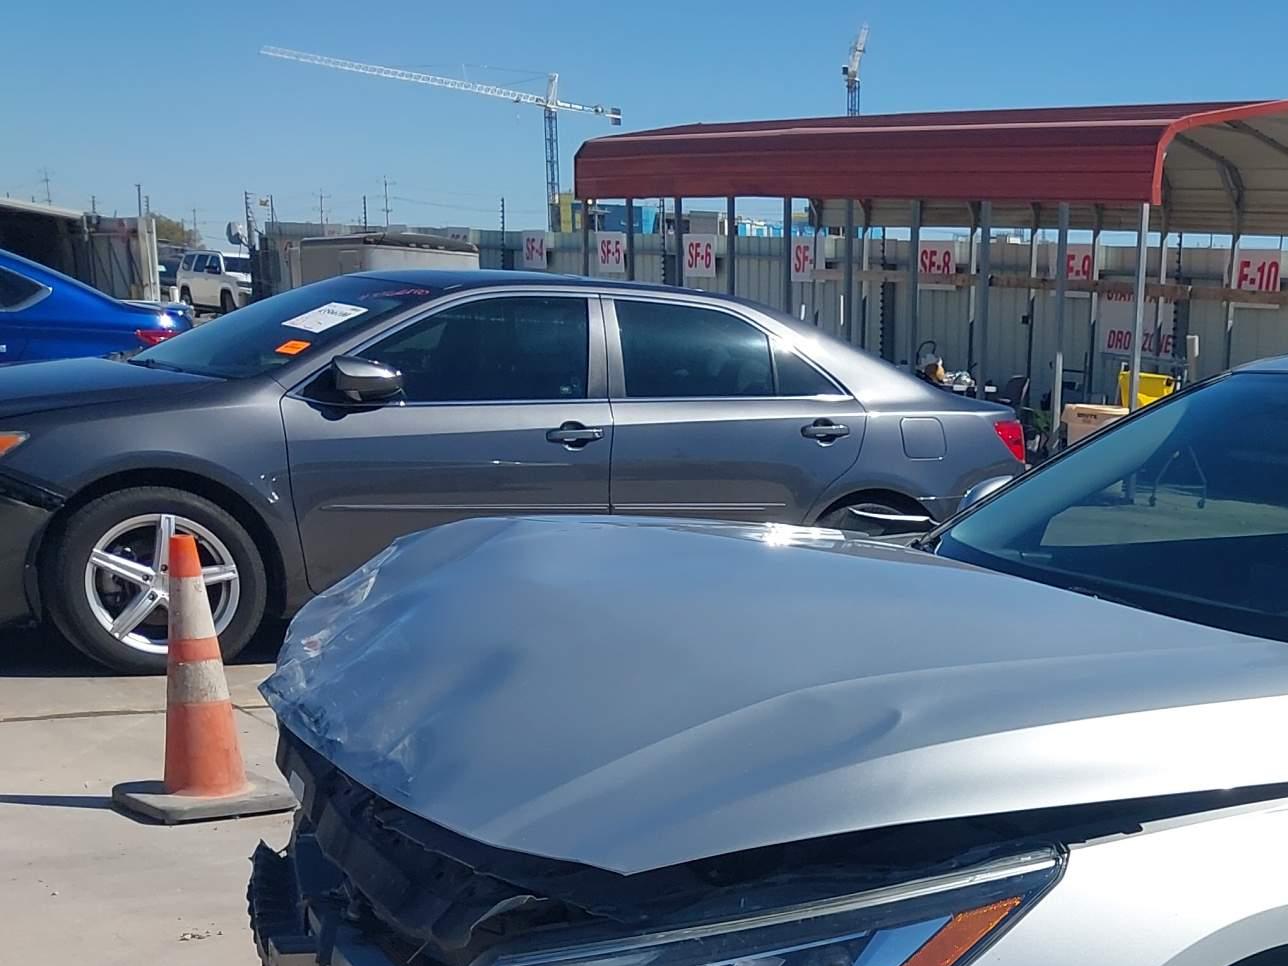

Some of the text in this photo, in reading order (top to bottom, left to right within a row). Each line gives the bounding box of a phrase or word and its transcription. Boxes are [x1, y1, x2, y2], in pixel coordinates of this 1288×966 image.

[526, 237, 543, 260] SF-4
[600, 239, 620, 264] SF-5
[688, 241, 711, 269] SF-6
[794, 245, 814, 273] SF-
[920, 249, 951, 275] SF-8
[1066, 254, 1093, 280] F-9
[1238, 260, 1280, 292] F-10
[1107, 330, 1133, 350] DRO
